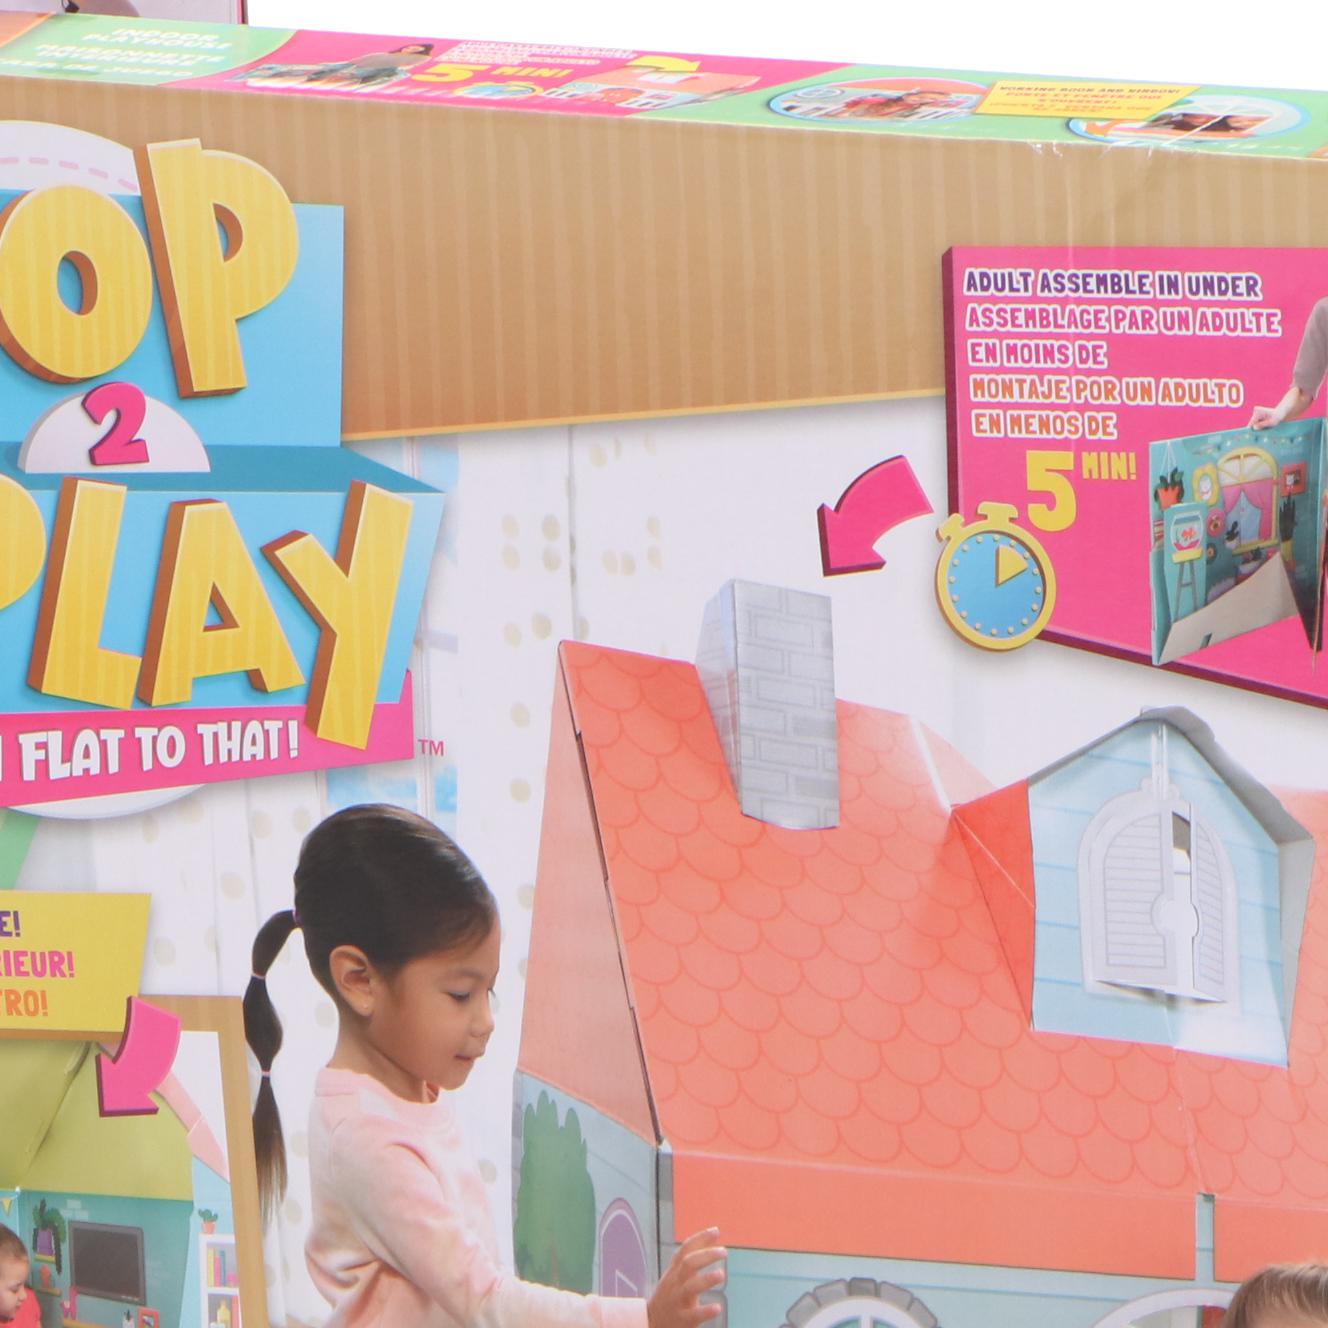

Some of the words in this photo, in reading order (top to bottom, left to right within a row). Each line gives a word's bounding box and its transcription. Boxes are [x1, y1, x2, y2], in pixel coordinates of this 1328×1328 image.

[966, 271, 1032, 294] ADULT
[1039, 271, 1152, 296] ASSEMBLE
[1158, 275, 1179, 296] IN
[1187, 275, 1260, 298] UNDER
[968, 307, 1107, 331] ASSEMBLAGE
[1114, 310, 1155, 331] PAR
[1163, 311, 1190, 332] UN
[1198, 311, 1280, 334] ADULTE
[971, 342, 998, 364] EN
[1005, 342, 1070, 365] MOINS
[1078, 344, 1106, 365] DE
[972, 377, 1068, 400] MONTAJE
[1076, 380, 1119, 402] POR
[1126, 380, 1153, 403] UN
[1161, 381, 1242, 405] ADULTO
[82, 382, 149, 466] 2
[974, 413, 1001, 435] EN
[1009, 413, 1080, 435] MENOS
[1088, 415, 1115, 437] DE
[1026, 450, 1077, 532] 5
[1082, 452, 1137, 480] MIN!
[20, 726, 122, 782] FLAT
[134, 724, 187, 769] TO
[197, 720, 299, 764] THAT!
